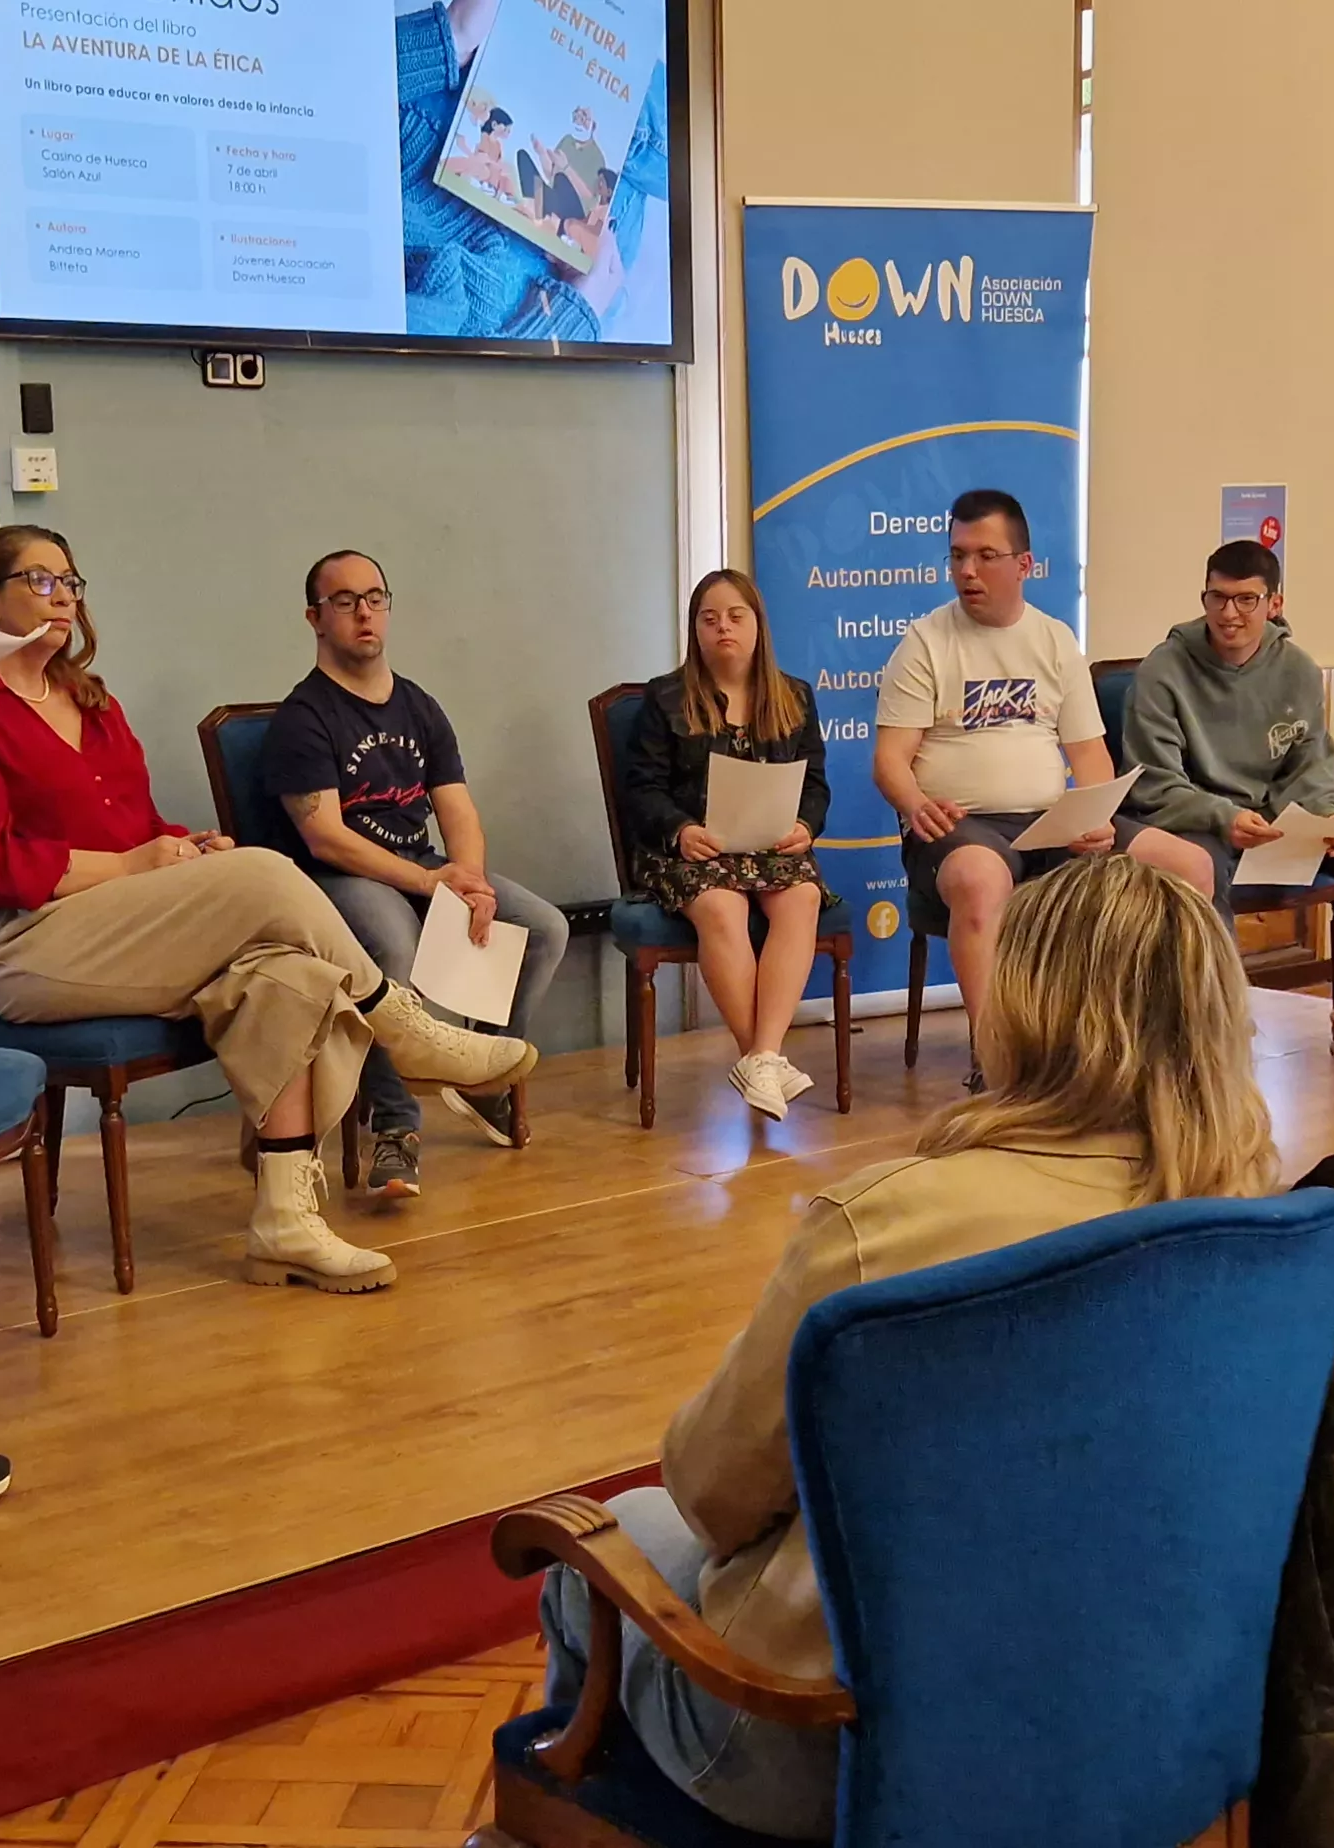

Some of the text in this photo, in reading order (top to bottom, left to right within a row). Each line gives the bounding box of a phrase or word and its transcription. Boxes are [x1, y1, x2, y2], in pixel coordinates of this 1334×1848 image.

[21, 3, 129, 29] Presentación
[133, 16, 159, 33] del
[163, 19, 197, 37] libro
[550, 27, 584, 60] DE LA
[22, 30, 265, 75] LA AVENTURA DE LA ÉTICA
[585, 58, 630, 103] ÉTICA
[25, 77, 315, 118] Un libro para educar en valores desde la infancia
[41, 127, 75, 142] Lugar
[41, 148, 148, 169] Casino de Huesca
[226, 145, 297, 162] Fecha y hora
[42, 166, 102, 182] Salón Azul
[227, 163, 278, 179] 7 de abril
[228, 180, 256, 194] 18:00
[47, 221, 87, 234] Autora
[230, 233, 297, 248] Ilustraciones
[48, 243, 141, 259] Andrea Moreno
[232, 254, 336, 270] Jóvenes Asociación
[232, 270, 306, 285] Down Huesca
[980, 275, 1063, 293] Asociación
[781, 254, 975, 323] DOWN
[981, 291, 1033, 308] DOWN
[981, 307, 1045, 324] HUESCA
[807, 563, 937, 589] Autonomía
[820, 720, 869, 743] Vida
